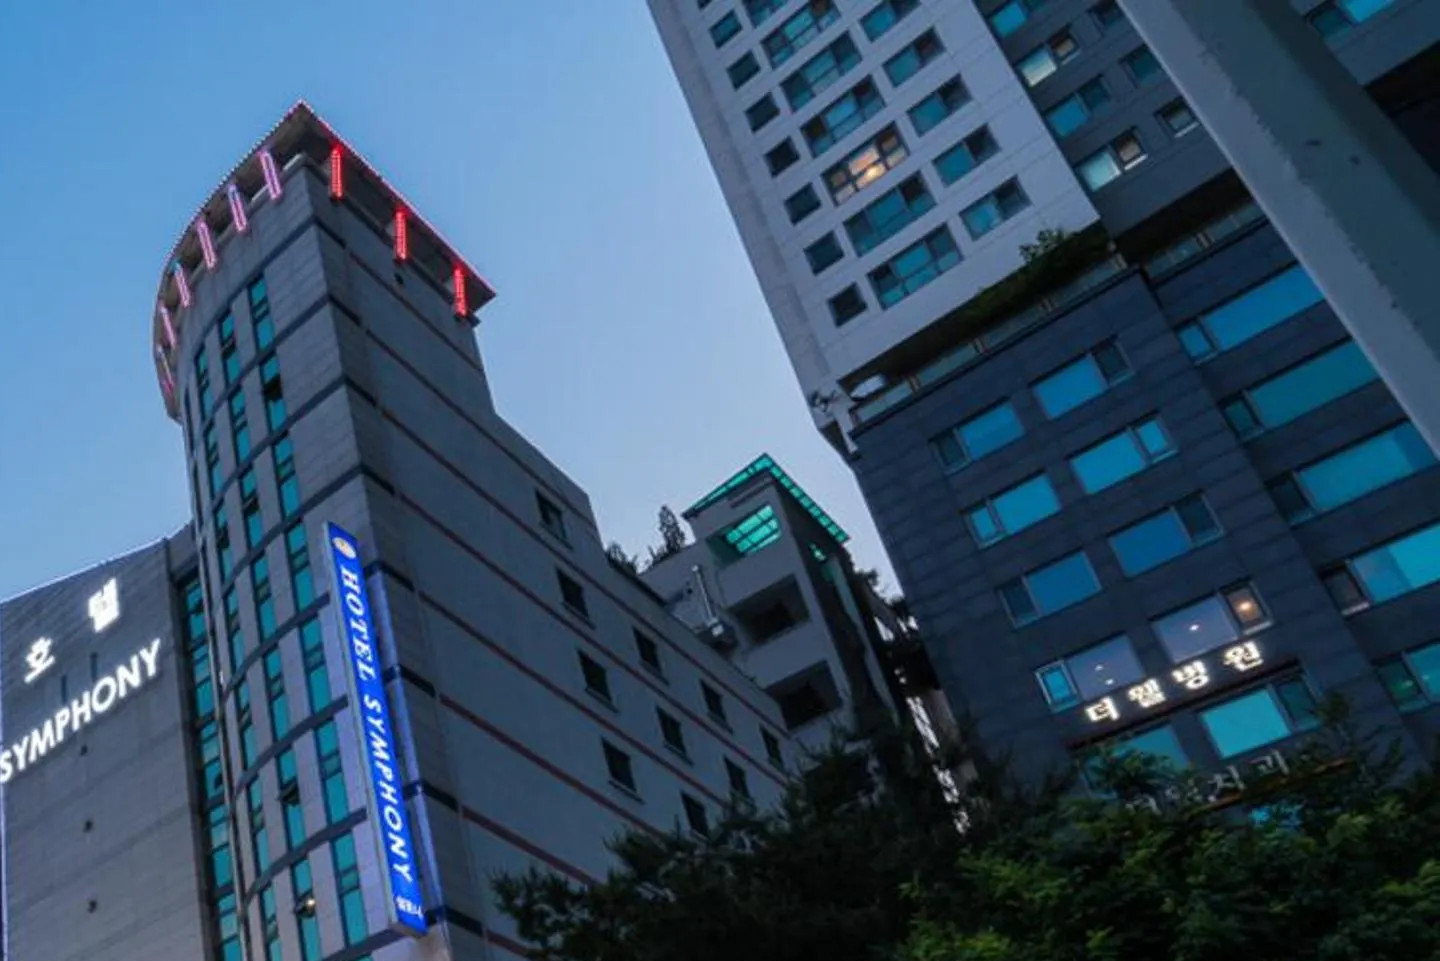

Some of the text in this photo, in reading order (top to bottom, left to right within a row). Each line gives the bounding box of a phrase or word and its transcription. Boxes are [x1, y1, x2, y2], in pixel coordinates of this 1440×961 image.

[24, 577, 120, 684] 호텔
[341, 565, 377, 682] HOTEL
[363, 694, 414, 883] SYMPHONY
